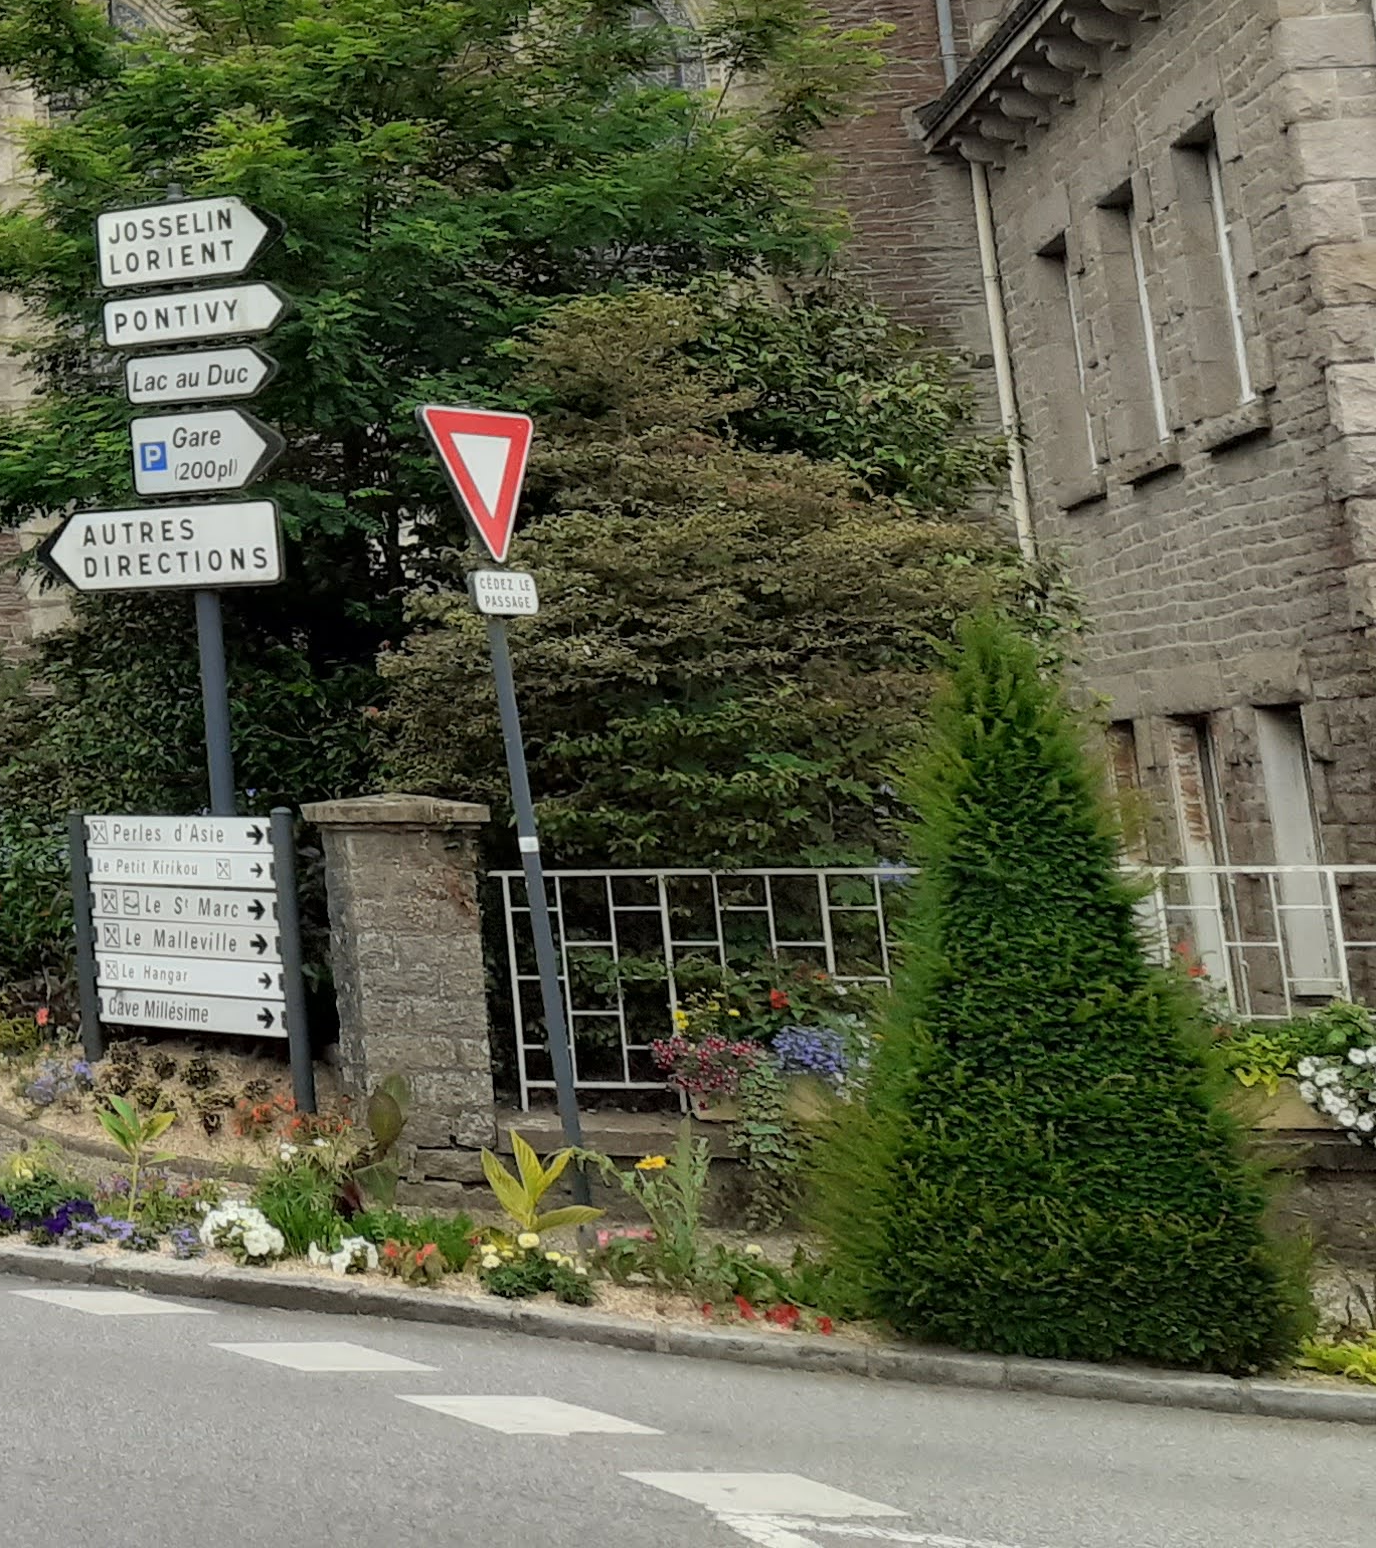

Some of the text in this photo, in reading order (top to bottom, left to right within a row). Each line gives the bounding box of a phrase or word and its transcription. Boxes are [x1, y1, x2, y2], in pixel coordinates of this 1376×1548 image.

[108, 208, 233, 245] JOSSELIN
[109, 240, 233, 275] LORIENT
[114, 299, 238, 334] PONTIVY
[132, 364, 249, 393] Lac au Duc
[172, 427, 222, 448] Gare
[174, 458, 238, 482] (200pl)
[82, 518, 194, 547] AUTRES
[84, 547, 268, 578] DIRECTIONS
[479, 574, 531, 592] CÉDEZ LE
[484, 595, 532, 609] PASSAGE
[113, 823, 224, 843] Perles d'Asie
[97, 858, 198, 876] Le Petit Kirikou
[145, 895, 161, 913] Le
[198, 897, 239, 918] Marc
[125, 927, 237, 953] Le Malleville
[122, 964, 188, 985] Le Hangar
[109, 996, 209, 1023] Cave Millésime
